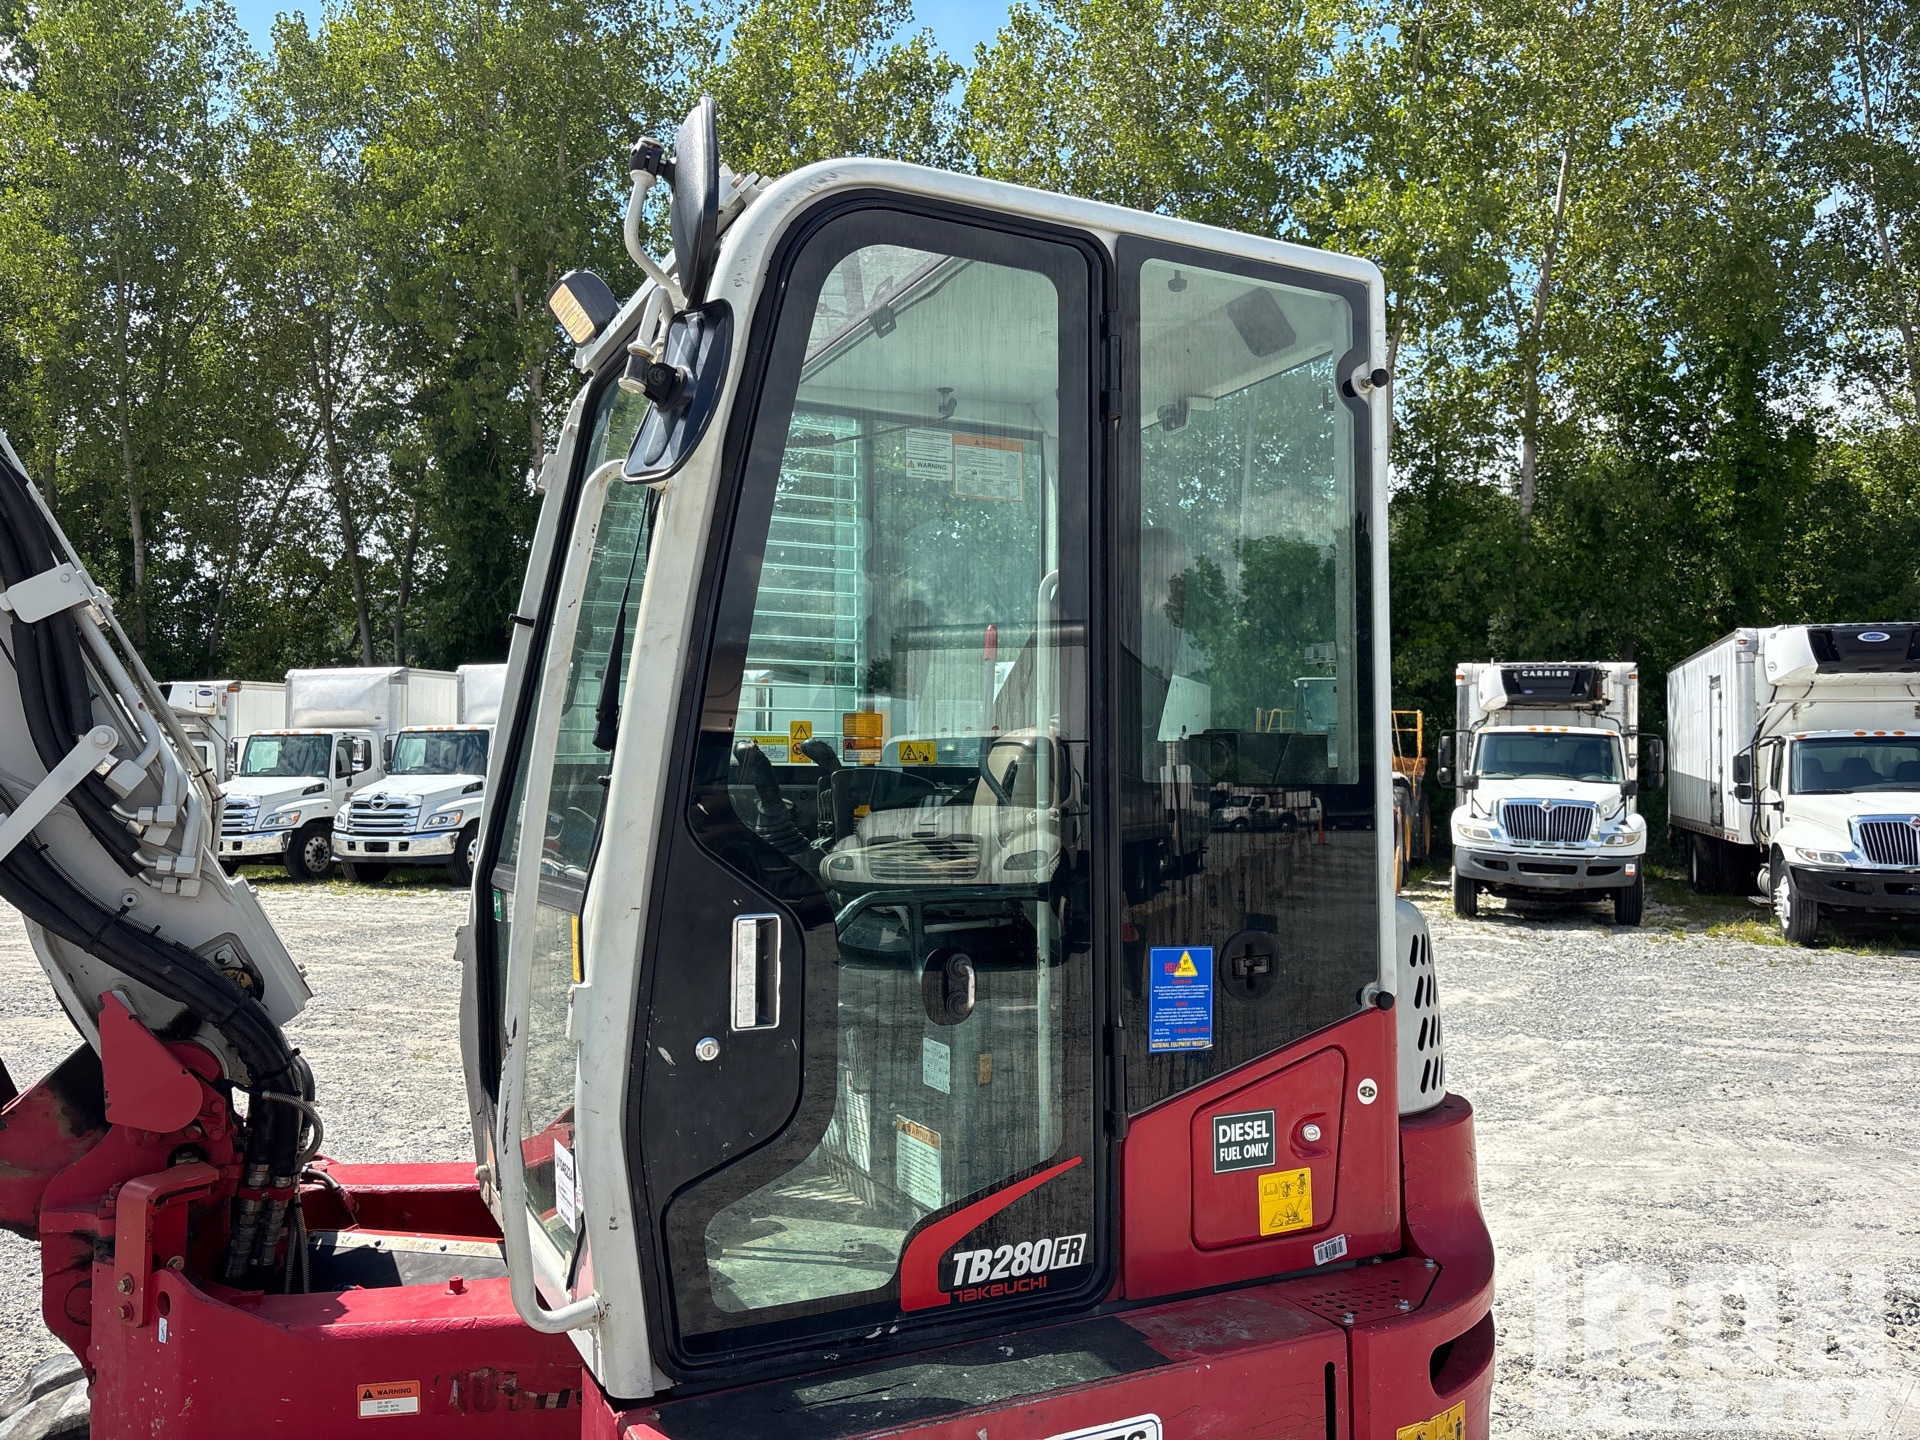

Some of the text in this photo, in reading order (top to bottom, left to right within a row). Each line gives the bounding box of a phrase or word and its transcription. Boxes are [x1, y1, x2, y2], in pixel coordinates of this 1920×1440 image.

[916, 461, 949, 471] WARNING:
[1218, 1120, 1270, 1144] DIESEL
[1219, 1142, 1269, 1162] FUEL ONLY
[377, 1388, 412, 1396] WARNING
